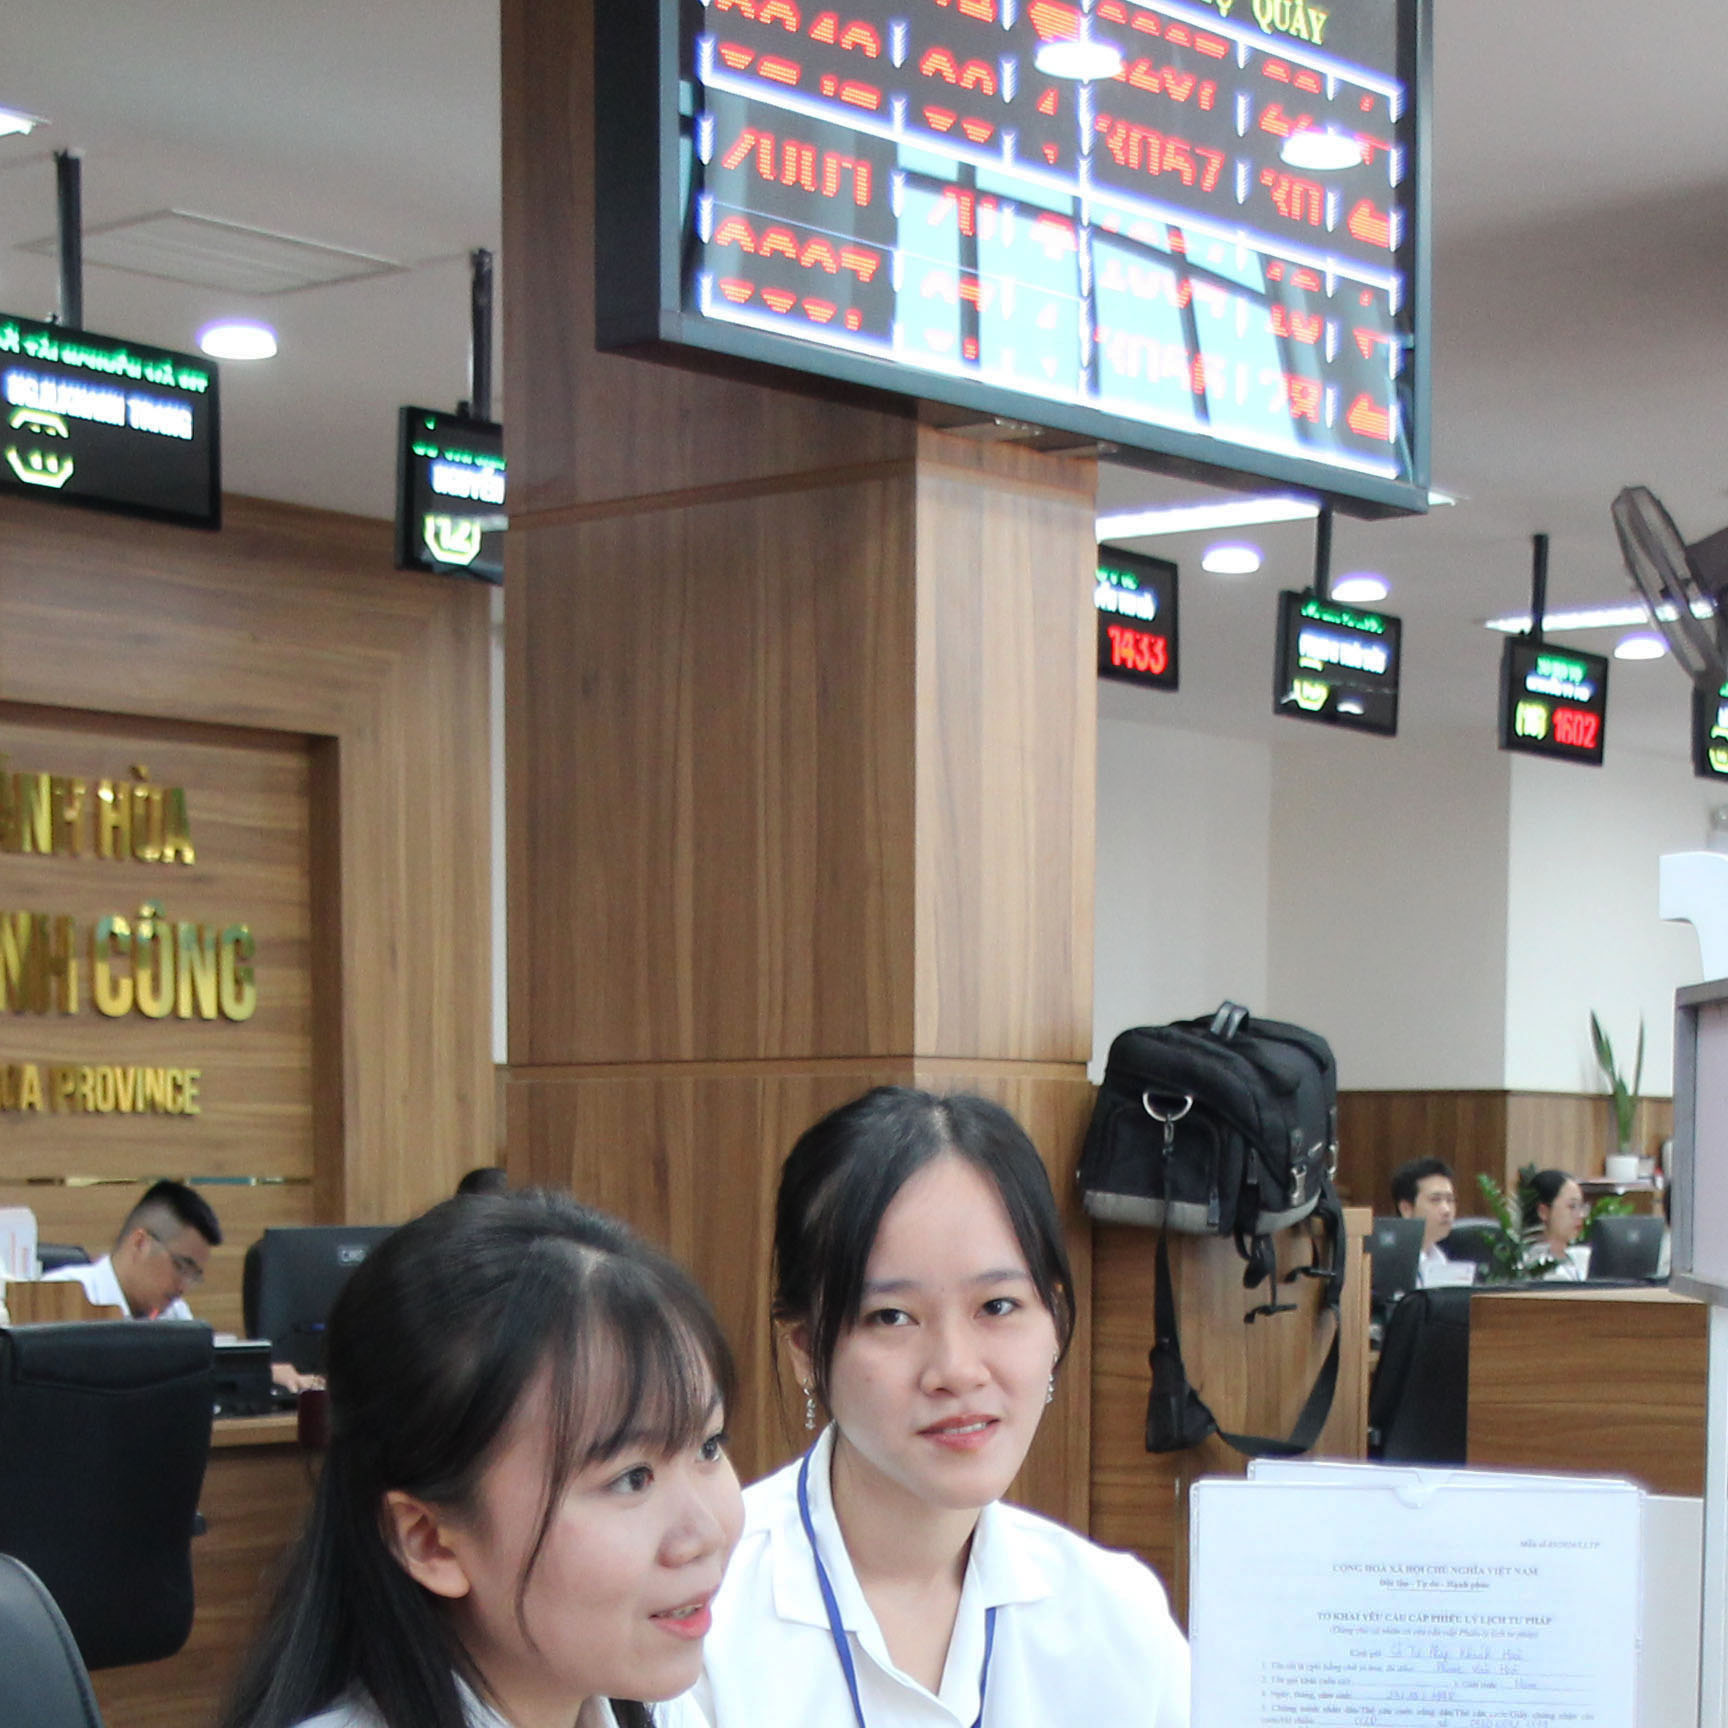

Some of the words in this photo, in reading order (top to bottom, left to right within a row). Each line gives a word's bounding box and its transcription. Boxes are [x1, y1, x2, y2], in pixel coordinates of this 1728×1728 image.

[1107, 624, 1168, 675] 1433
[96, 764, 196, 866] HÒA
[93, 899, 258, 1022] CÔNG
[50, 1065, 202, 1115] PROVINCE
